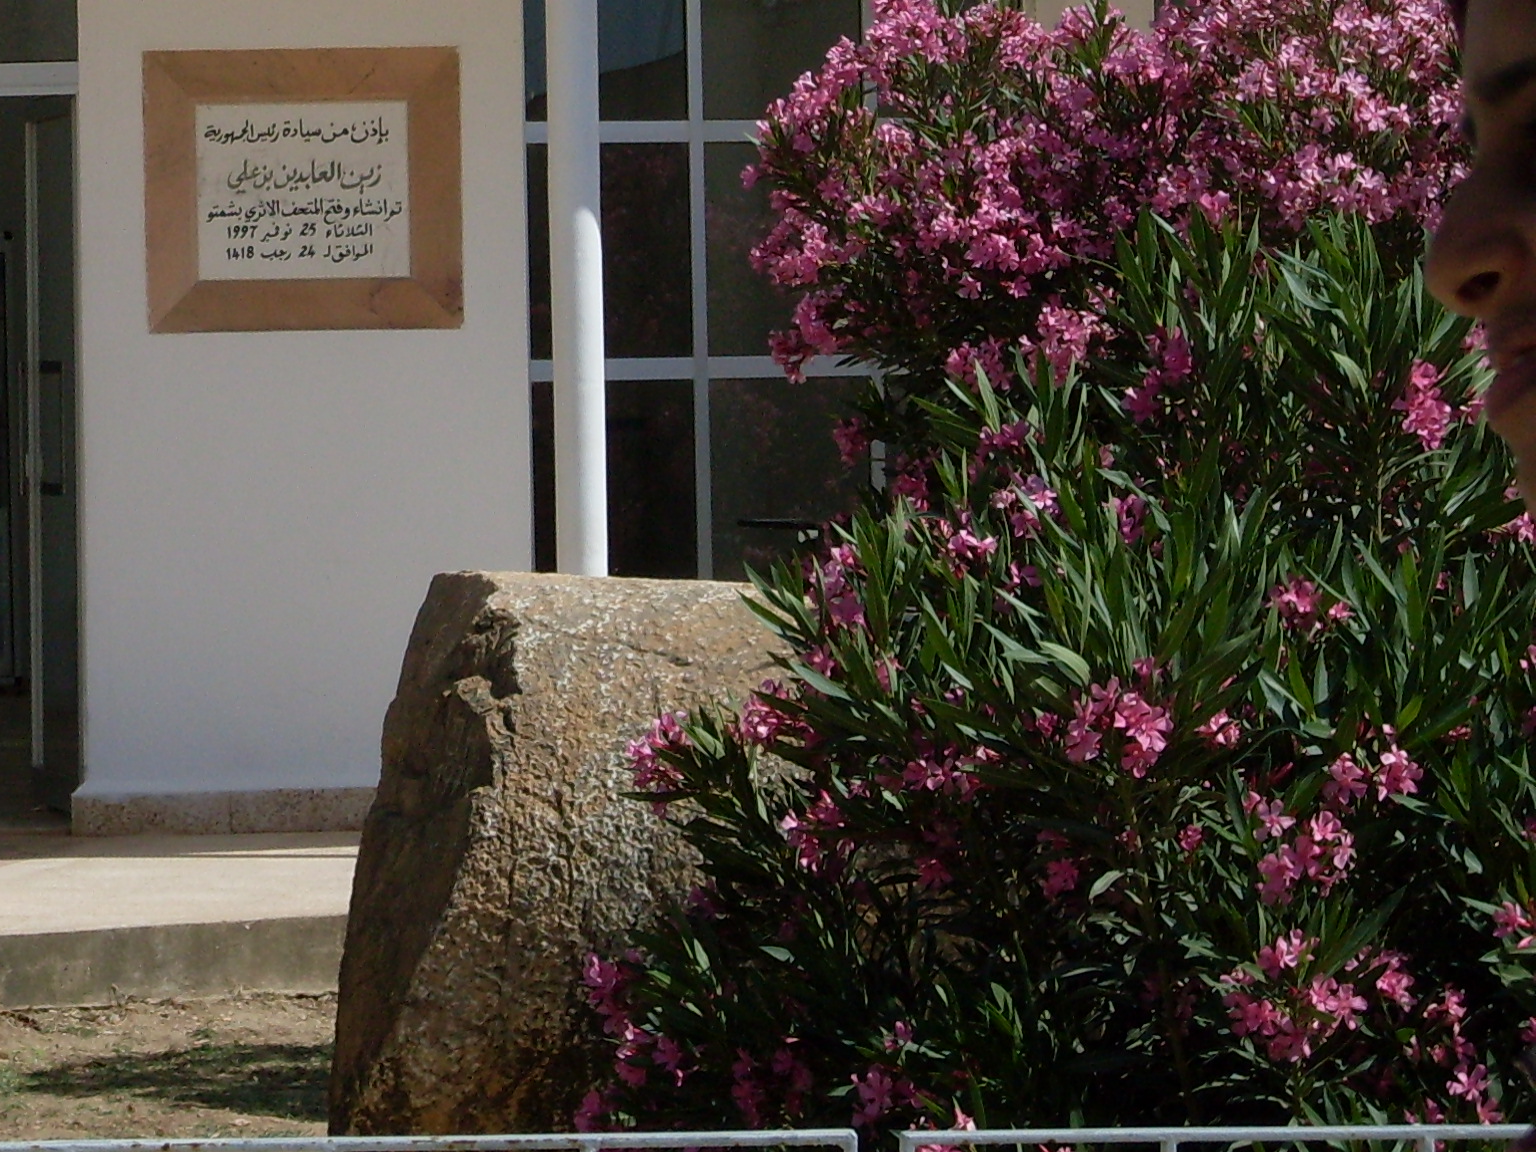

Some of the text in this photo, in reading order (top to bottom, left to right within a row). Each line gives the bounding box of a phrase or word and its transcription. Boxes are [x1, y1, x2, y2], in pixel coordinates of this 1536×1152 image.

[204, 119, 254, 145] الجمهورية
[247, 123, 280, 143] رئيس
[283, 118, 322, 142] سيادة
[321, 122, 349, 143] من
[227, 159, 383, 195] زين العابدين بن علي
[282, 197, 324, 216] المتحف
[383, 201, 402, 222] تم
[227, 225, 258, 239] 1997
[299, 222, 317, 236] 25
[325, 223, 373, 239] الثلاثاء
[226, 245, 255, 260] 1418
[260, 249, 291, 261] رجب
[298, 245, 316, 258] 24
